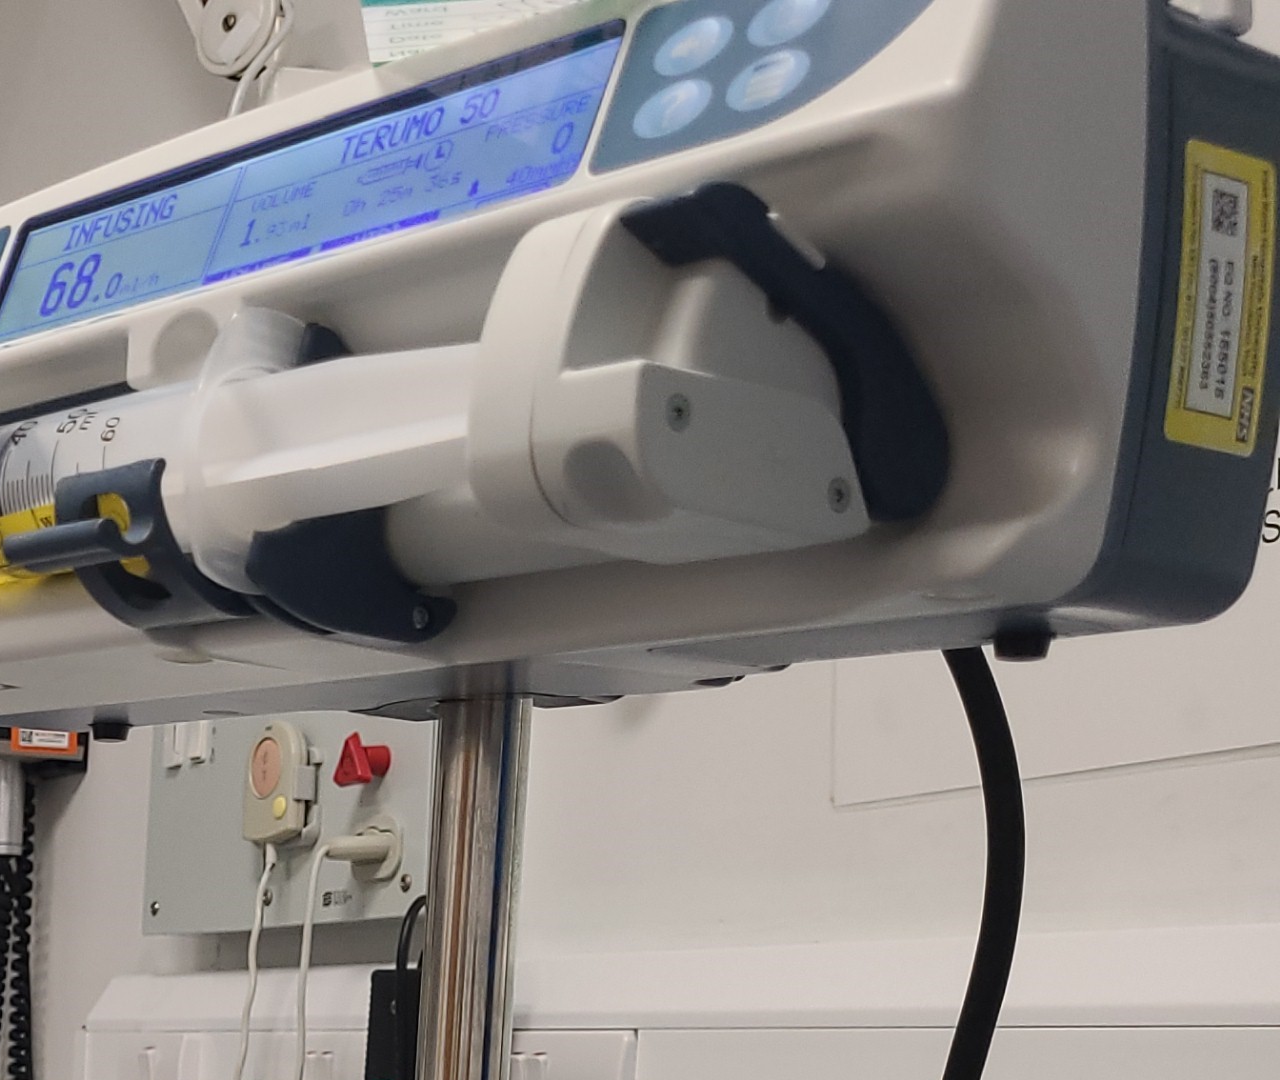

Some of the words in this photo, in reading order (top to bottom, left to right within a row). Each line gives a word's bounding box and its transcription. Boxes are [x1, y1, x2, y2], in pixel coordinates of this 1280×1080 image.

[341, 107, 445, 164] TERUMO
[460, 87, 500, 125] 50
[64, 194, 178, 251] INFUSING
[11, 420, 38, 446] 40
[57, 408, 88, 433] 50
[101, 416, 120, 442] 60
